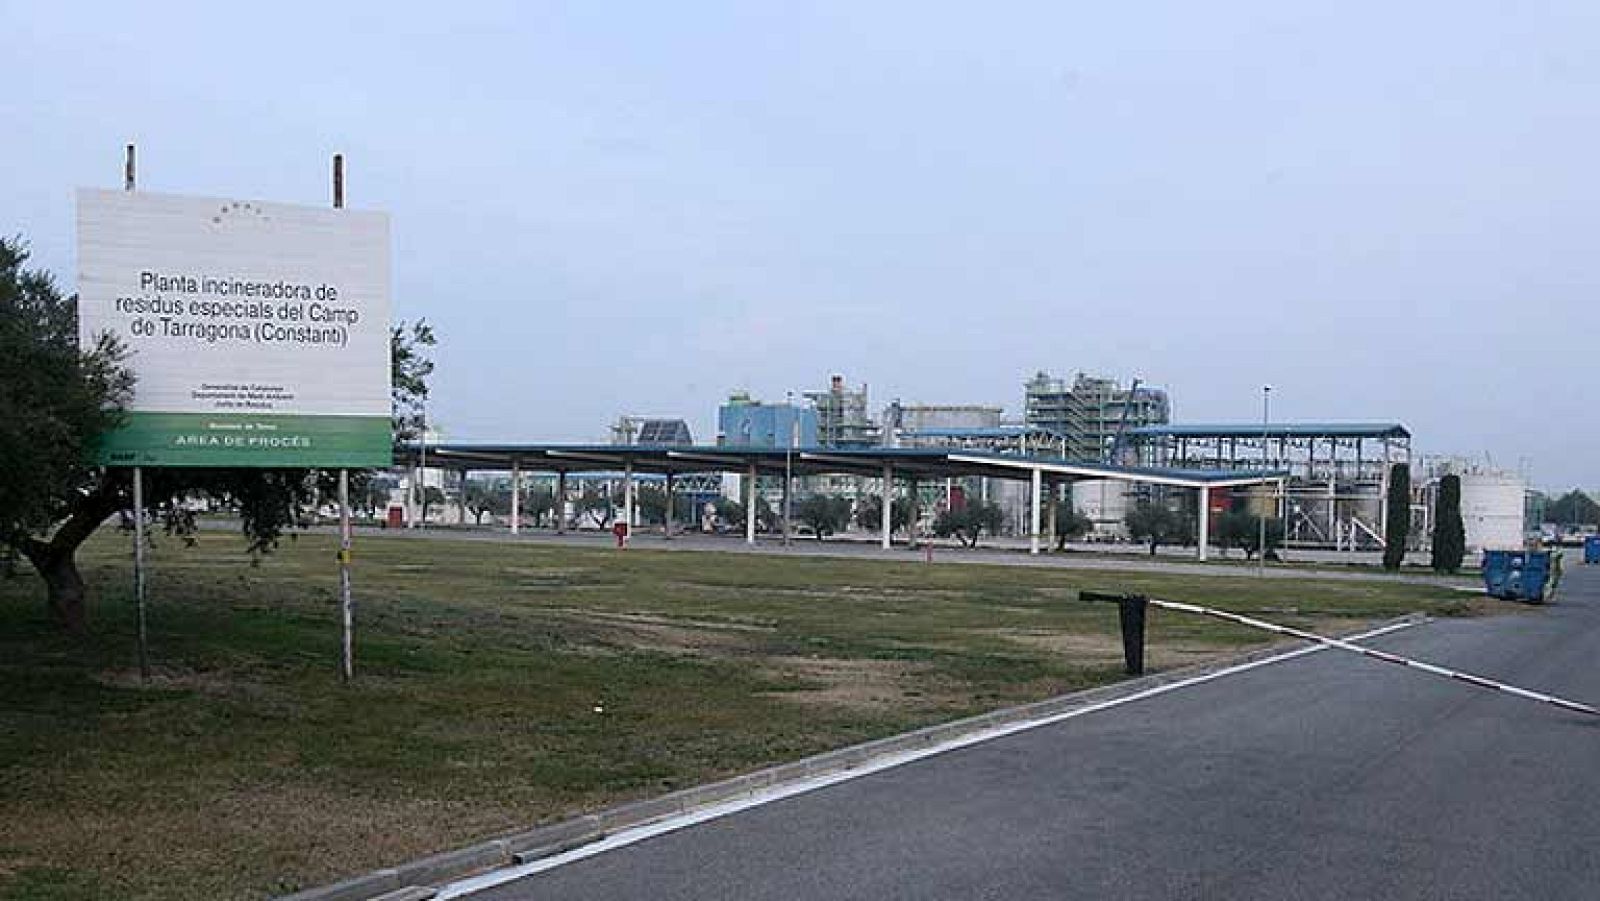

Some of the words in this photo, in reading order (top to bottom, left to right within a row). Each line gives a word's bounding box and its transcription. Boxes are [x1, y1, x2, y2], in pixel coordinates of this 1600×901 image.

[141, 272, 198, 293] Planta
[202, 275, 311, 301] incineradora
[315, 283, 337, 301] de
[116, 295, 184, 316] residus
[189, 298, 274, 322] especials
[277, 302, 303, 320] del
[309, 303, 359, 326] Camp
[131, 317, 155, 337] de
[160, 316, 250, 342] Tarragona
